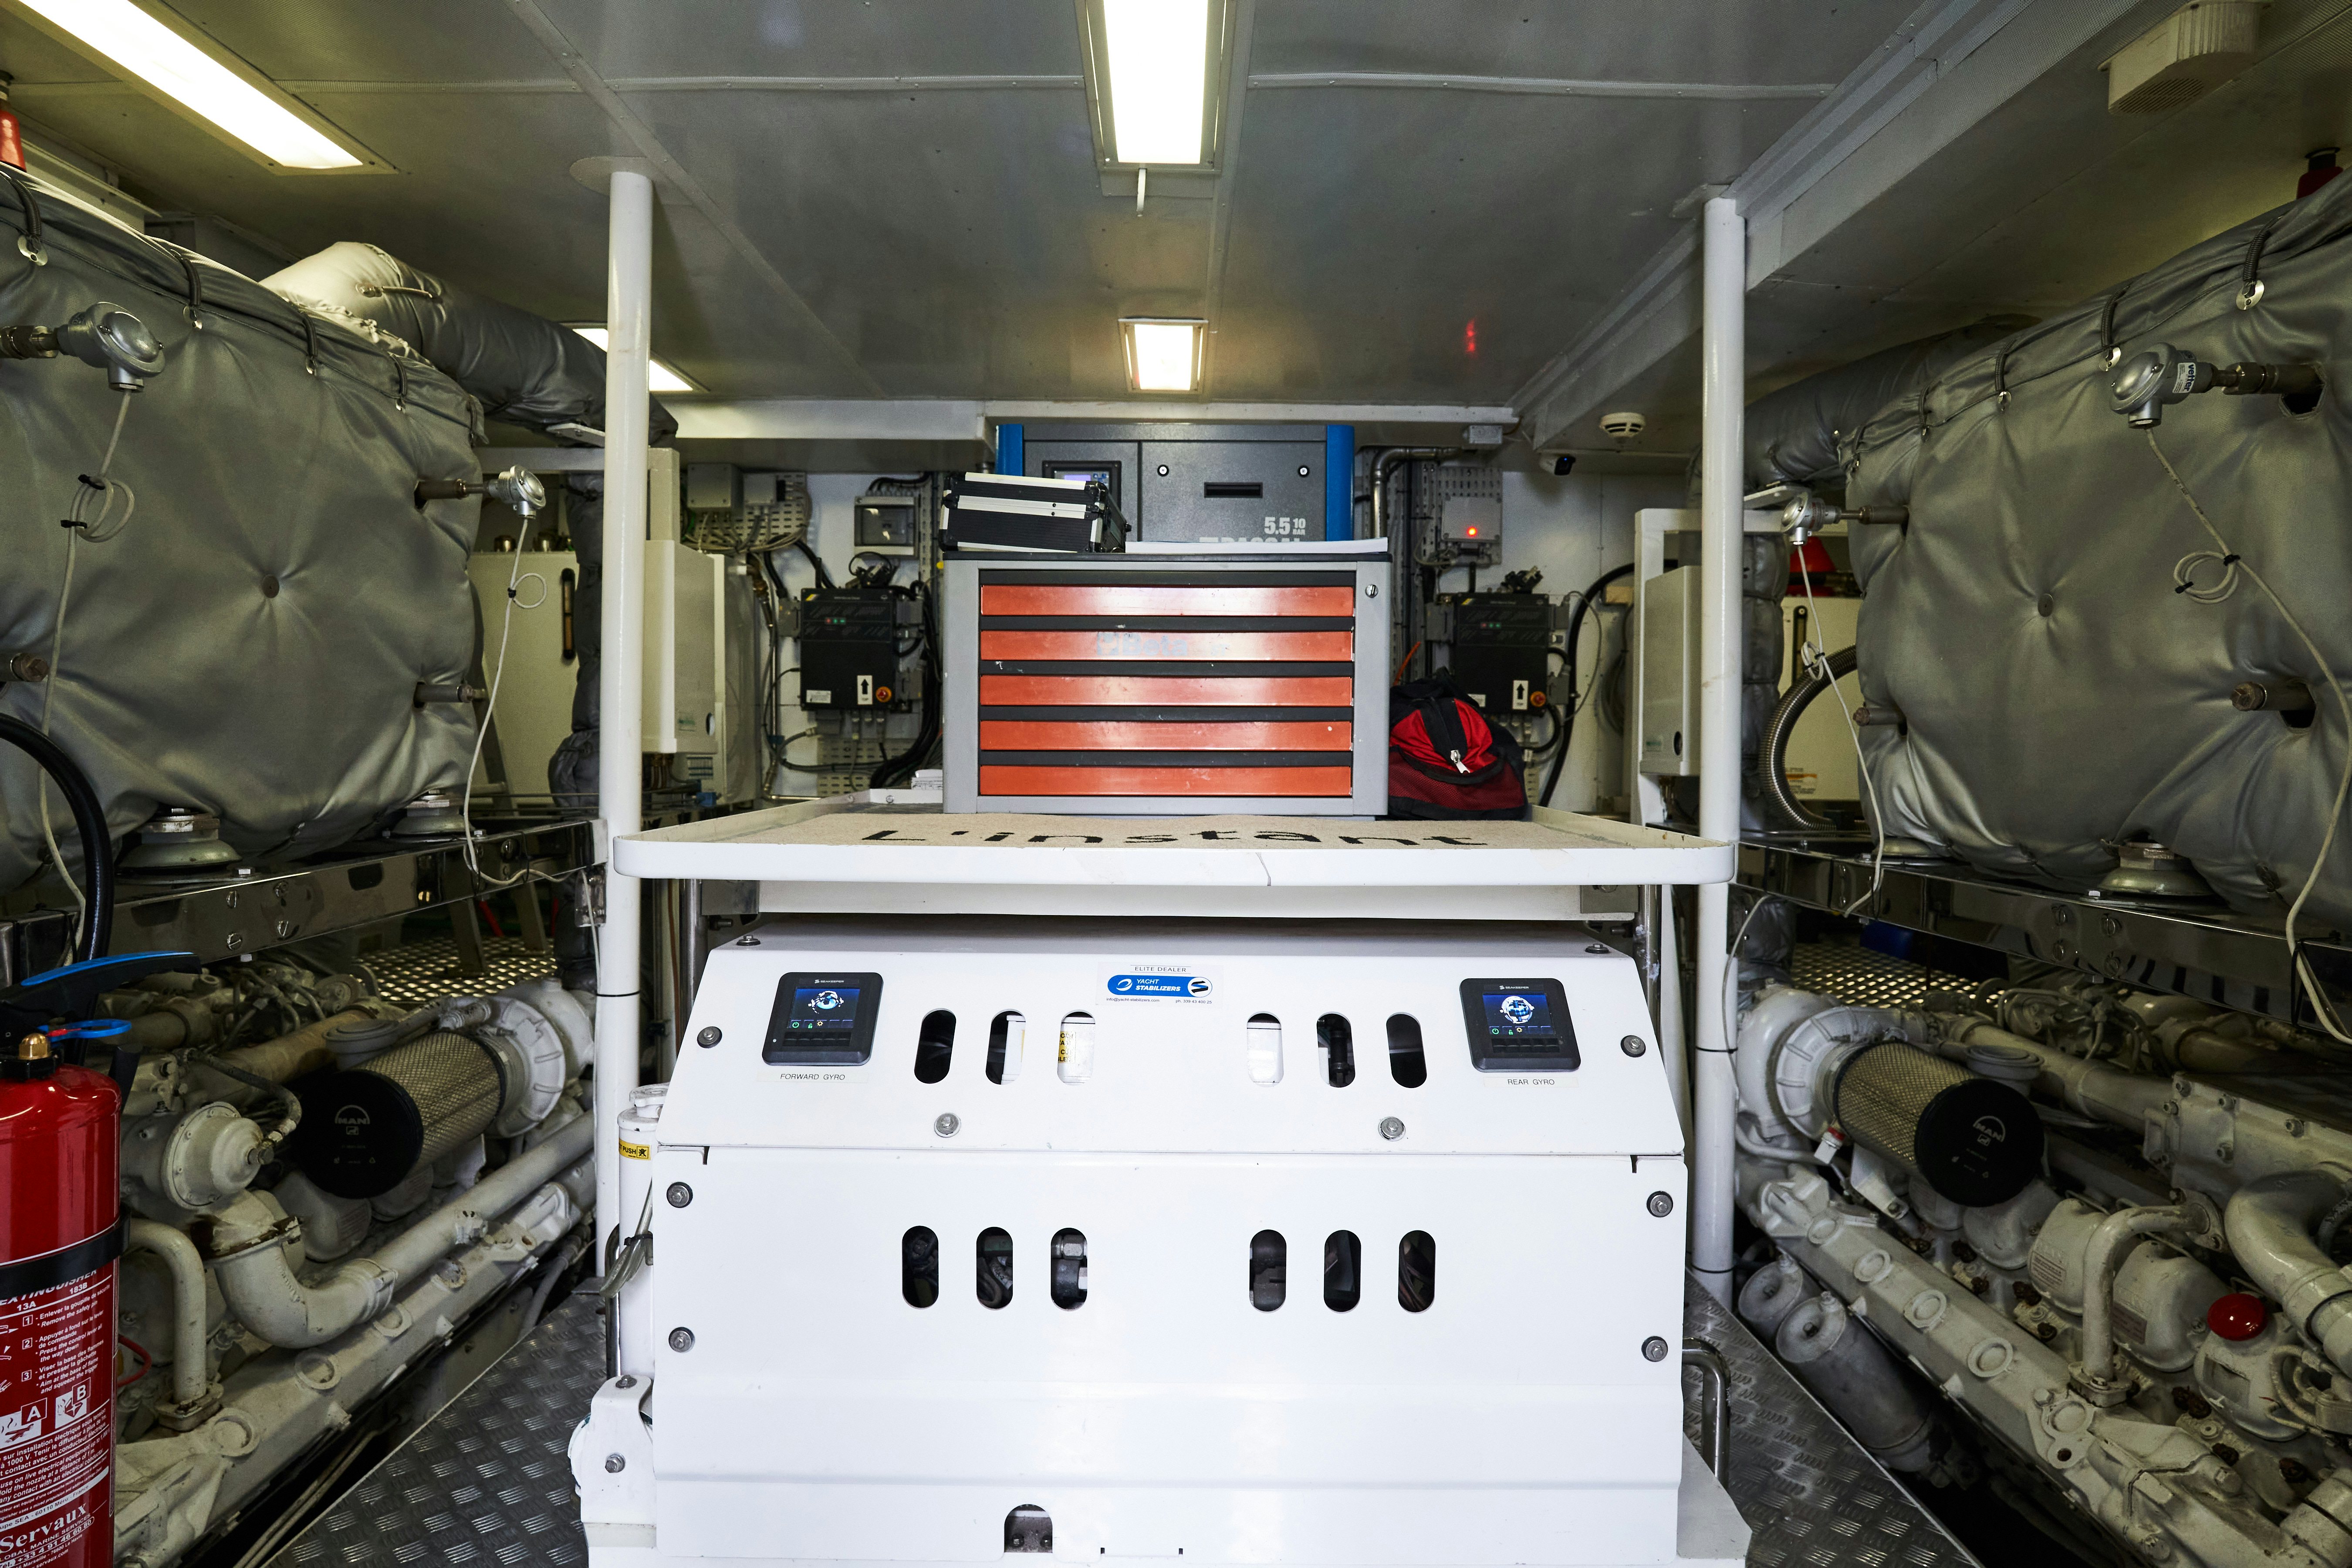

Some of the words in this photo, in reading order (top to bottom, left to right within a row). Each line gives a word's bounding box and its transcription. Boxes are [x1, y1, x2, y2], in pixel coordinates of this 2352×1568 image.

[2184, 364, 2195, 391] vetter
[1264, 517, 1291, 534] 5.5
[1293, 518, 1306, 529] 10
[1122, 633, 1188, 656] Beta
[1975, 1123, 2002, 1141] MAN
[622, 1146, 636, 1154] PUSH
[70, 1282, 88, 1294] 183B
[17, 1301, 36, 1311] 13A
[40, 1308, 63, 1319] Enlever
[71, 1296, 90, 1309] goupille
[41, 1315, 65, 1327] Remove
[76, 1304, 91, 1315] safety
[39, 1329, 64, 1342] Appuyer
[69, 1321, 80, 1330] fond
[39, 1346, 57, 1356] Press
[58, 1341, 68, 1349] the
[68, 1332, 86, 1345] control
[87, 1327, 97, 1336] lever
[47, 1330, 77, 1345] commande
[65, 1343, 79, 1353] down
[39, 1362, 56, 1373] Viser
[64, 1355, 76, 1363] base
[47, 1364, 69, 1378] presser
[70, 1367, 81, 1375] base
[54, 1375, 75, 1388] squeeze
[77, 1385, 86, 1401] B
[27, 1406, 41, 1422] A
[17, 1439, 53, 1456] installation
[54, 1425, 81, 1441] électrique
[81, 1418, 92, 1428] sous
[5, 1461, 31, 1474] contact
[33, 1455, 48, 1465] avec
[59, 1435, 87, 1453] conducteur
[7, 1456, 23, 1466] 1000
[34, 1447, 51, 1457] Tenir
[58, 1431, 81, 1446] diffuseur
[38, 1458, 64, 1474] electrical
[65, 1444, 90, 1462] equipment
[0, 1486, 12, 1495] old
[26, 1475, 46, 1487] nozzle
[60, 1457, 81, 1472] distance
[13, 1484, 38, 1498] contact
[39, 1479, 52, 1488] with
[62, 1461, 84, 1478] electrical
[15, 1515, 29, 1524] SEA
[35, 1504, 53, 1516] 60110
[0, 1503, 86, 1554] Servaux
[30, 1533, 59, 1550] MARINE
[61, 1513, 91, 1534] SERVICES
[18, 1551, 35, 1562] +33
[47, 1541, 57, 1550] 91
[61, 1533, 71, 1542] 46
[73, 1526, 82, 1535] 60
[84, 1519, 91, 1528] 80
[23, 1555, 46, 1567] Marseille
